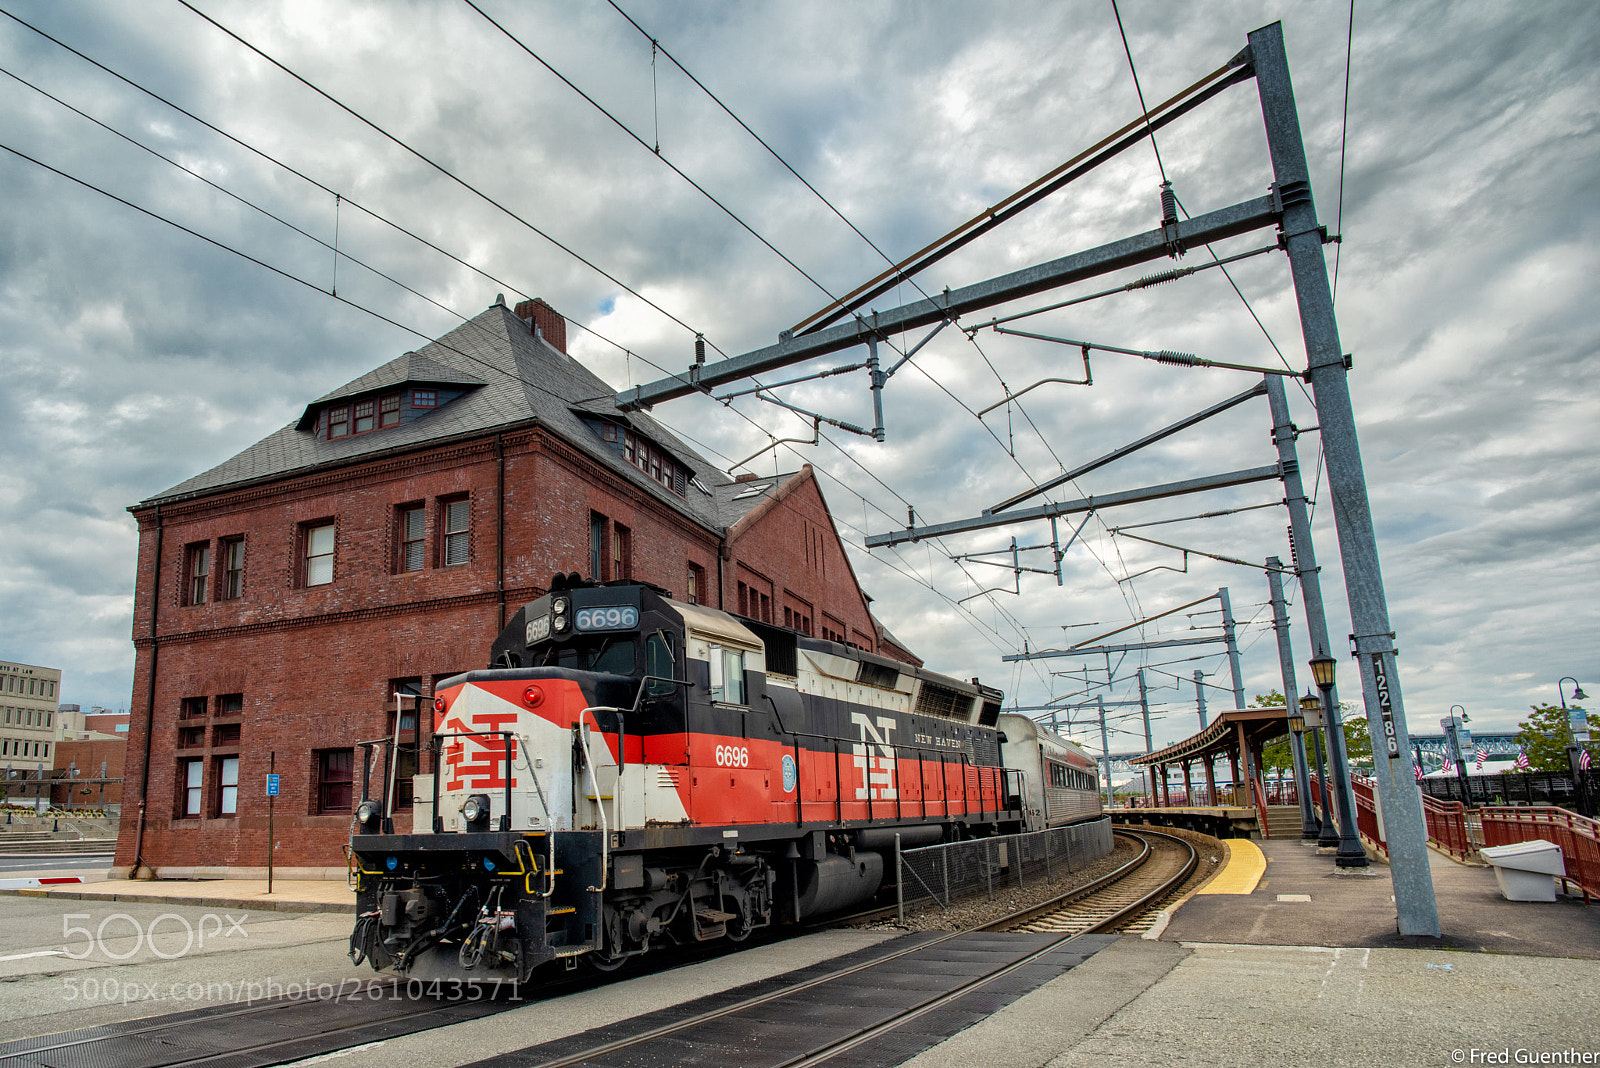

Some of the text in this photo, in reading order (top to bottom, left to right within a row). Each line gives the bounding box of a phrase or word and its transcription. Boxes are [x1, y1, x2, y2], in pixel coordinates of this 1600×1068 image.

[526, 617, 550, 643] 6696
[576, 608, 635, 630] 6696
[1374, 659, 1398, 752] 122-86
[914, 733, 961, 749] NEW HAVEN
[715, 744, 749, 768] 6696
